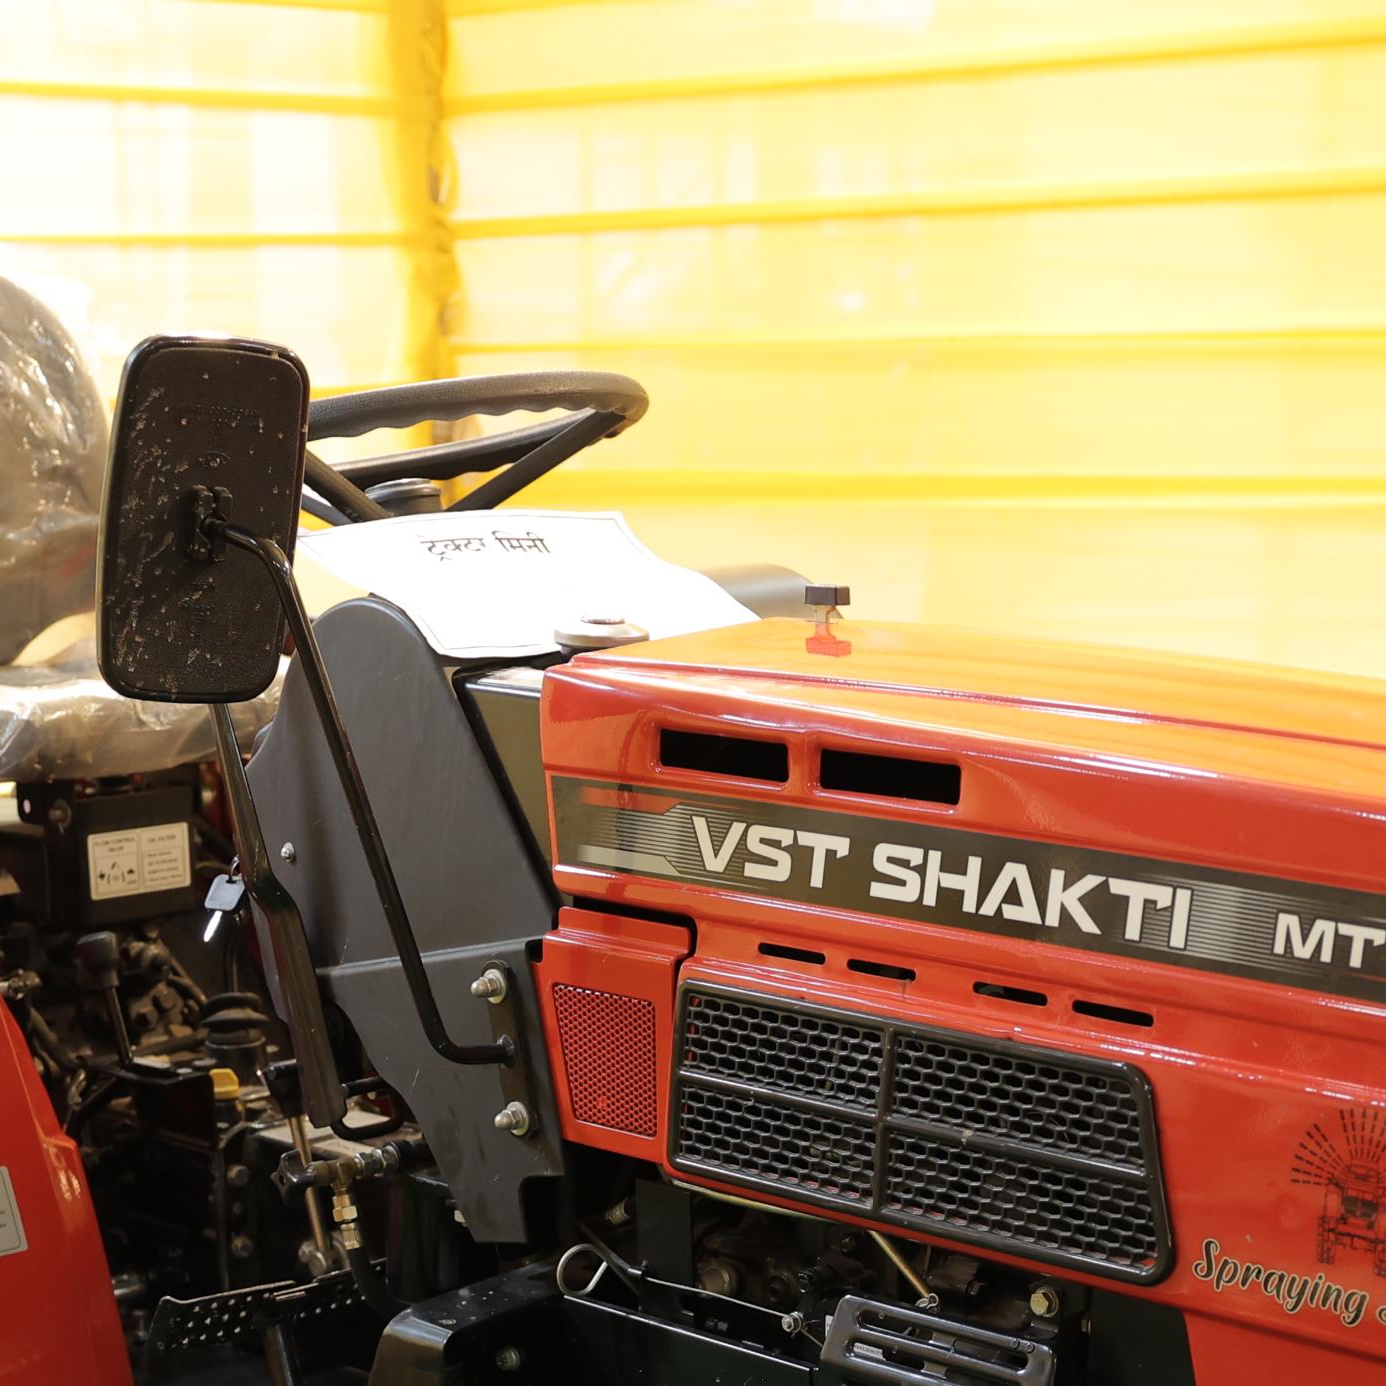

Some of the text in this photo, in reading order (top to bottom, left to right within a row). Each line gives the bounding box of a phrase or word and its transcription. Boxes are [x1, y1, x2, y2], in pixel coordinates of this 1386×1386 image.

[491, 530, 551, 553] मिनी
[690, 814, 1193, 950] VST SHAKTI
[1273, 911, 1386, 969] MT
[1193, 1239, 1370, 1327] Spraying
